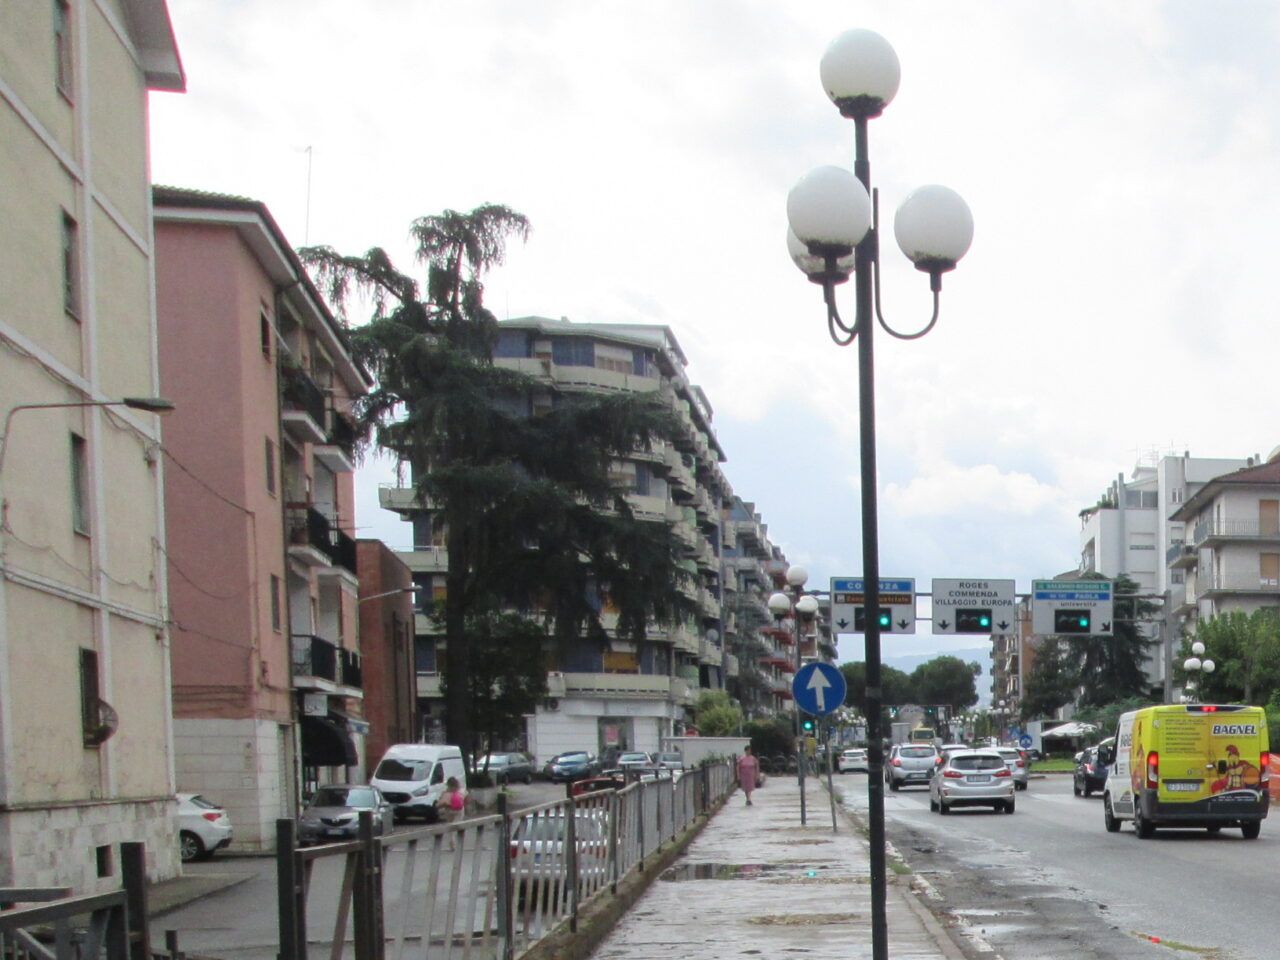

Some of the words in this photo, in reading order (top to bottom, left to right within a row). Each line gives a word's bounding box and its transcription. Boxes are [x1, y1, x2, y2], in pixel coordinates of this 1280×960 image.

[847, 582, 898, 590] CONZA
[949, 590, 998, 598] COMMENDA
[981, 599, 1013, 607] EUROPA
[1212, 725, 1257, 735] BAGNEL
